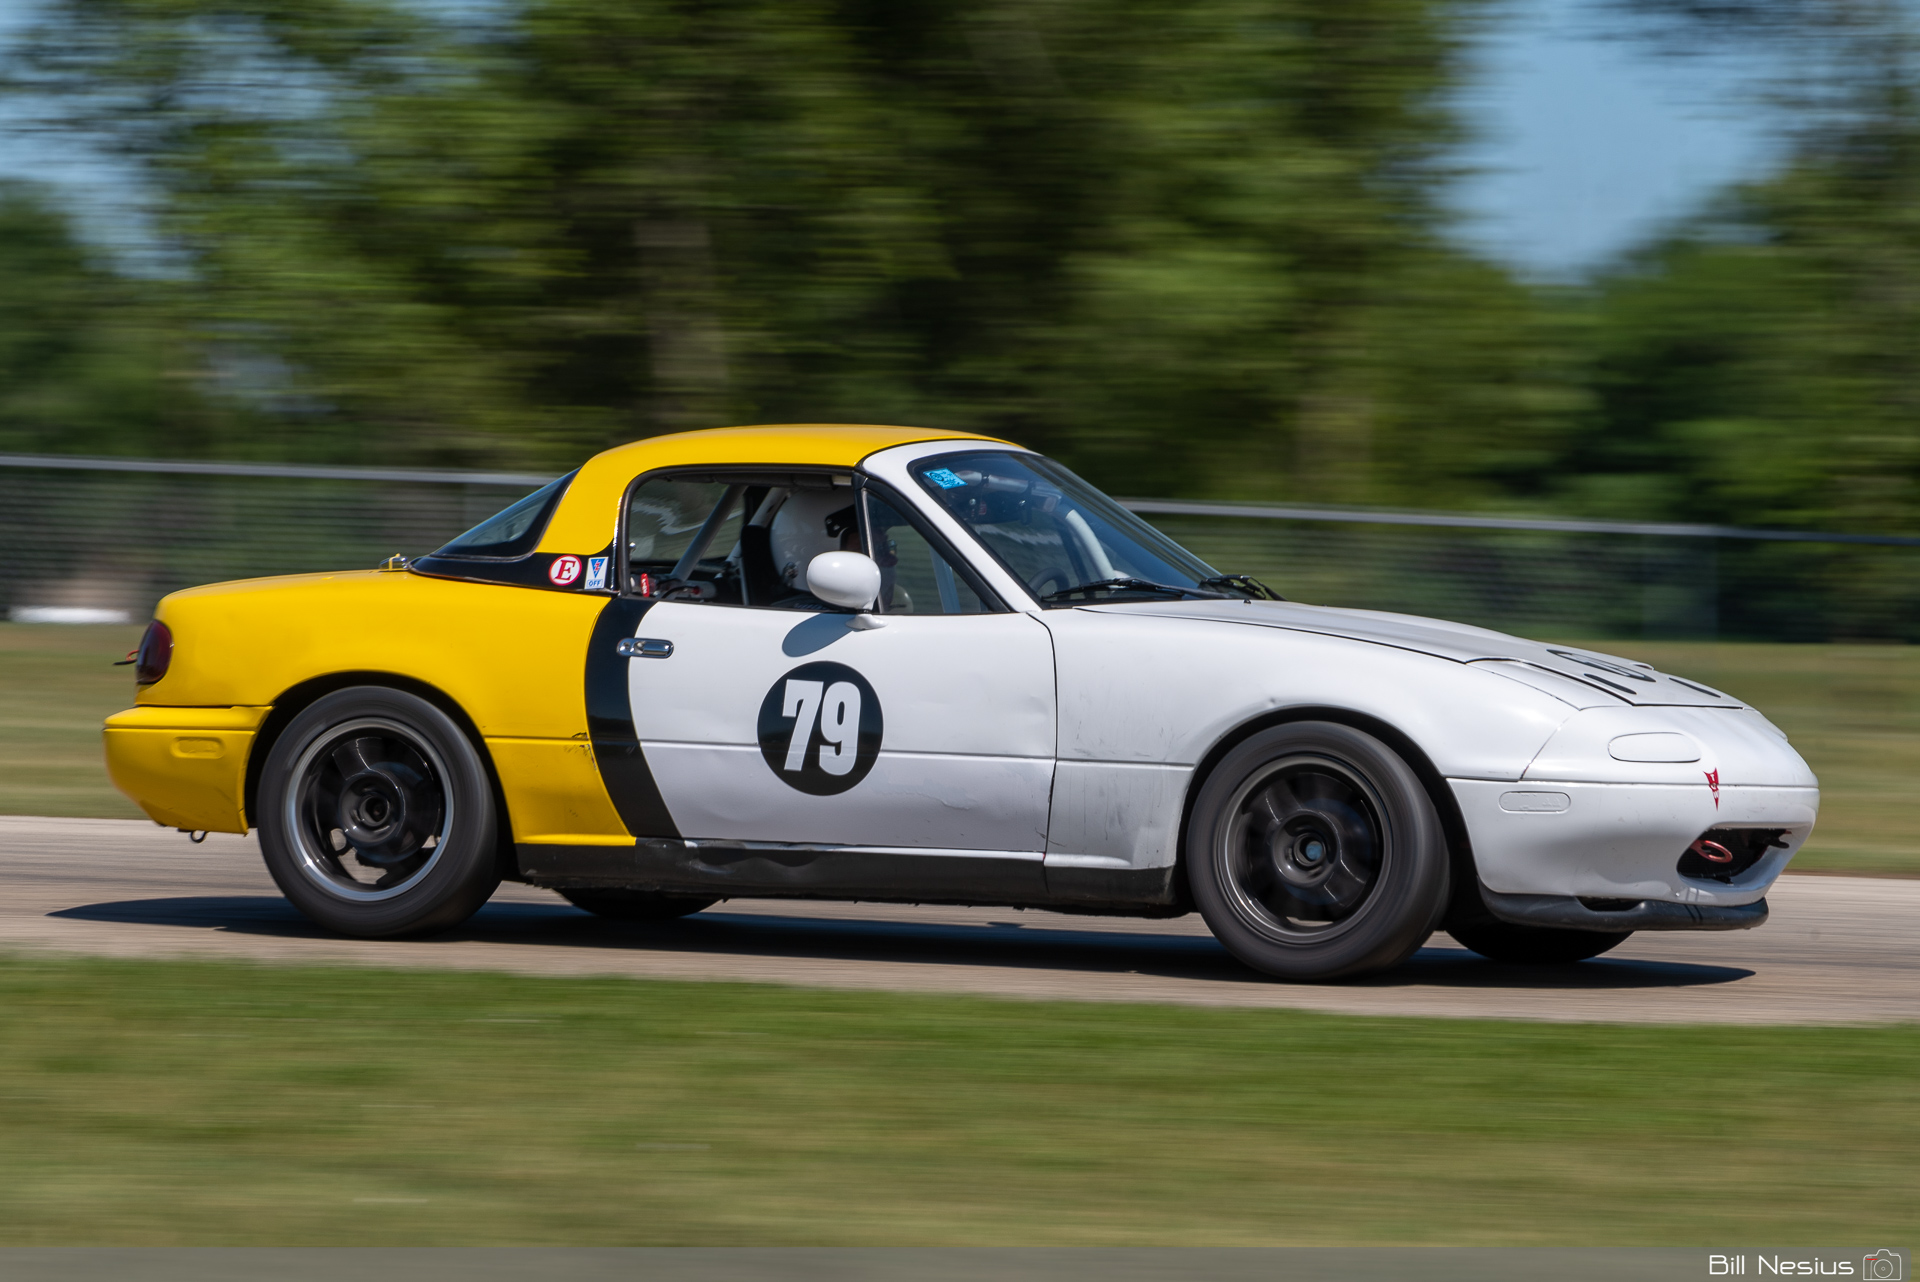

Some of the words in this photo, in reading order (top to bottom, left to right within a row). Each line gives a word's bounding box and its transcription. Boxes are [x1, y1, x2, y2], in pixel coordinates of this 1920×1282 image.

[554, 559, 576, 581] E
[588, 579, 601, 587] OFF
[782, 679, 862, 776] 79
